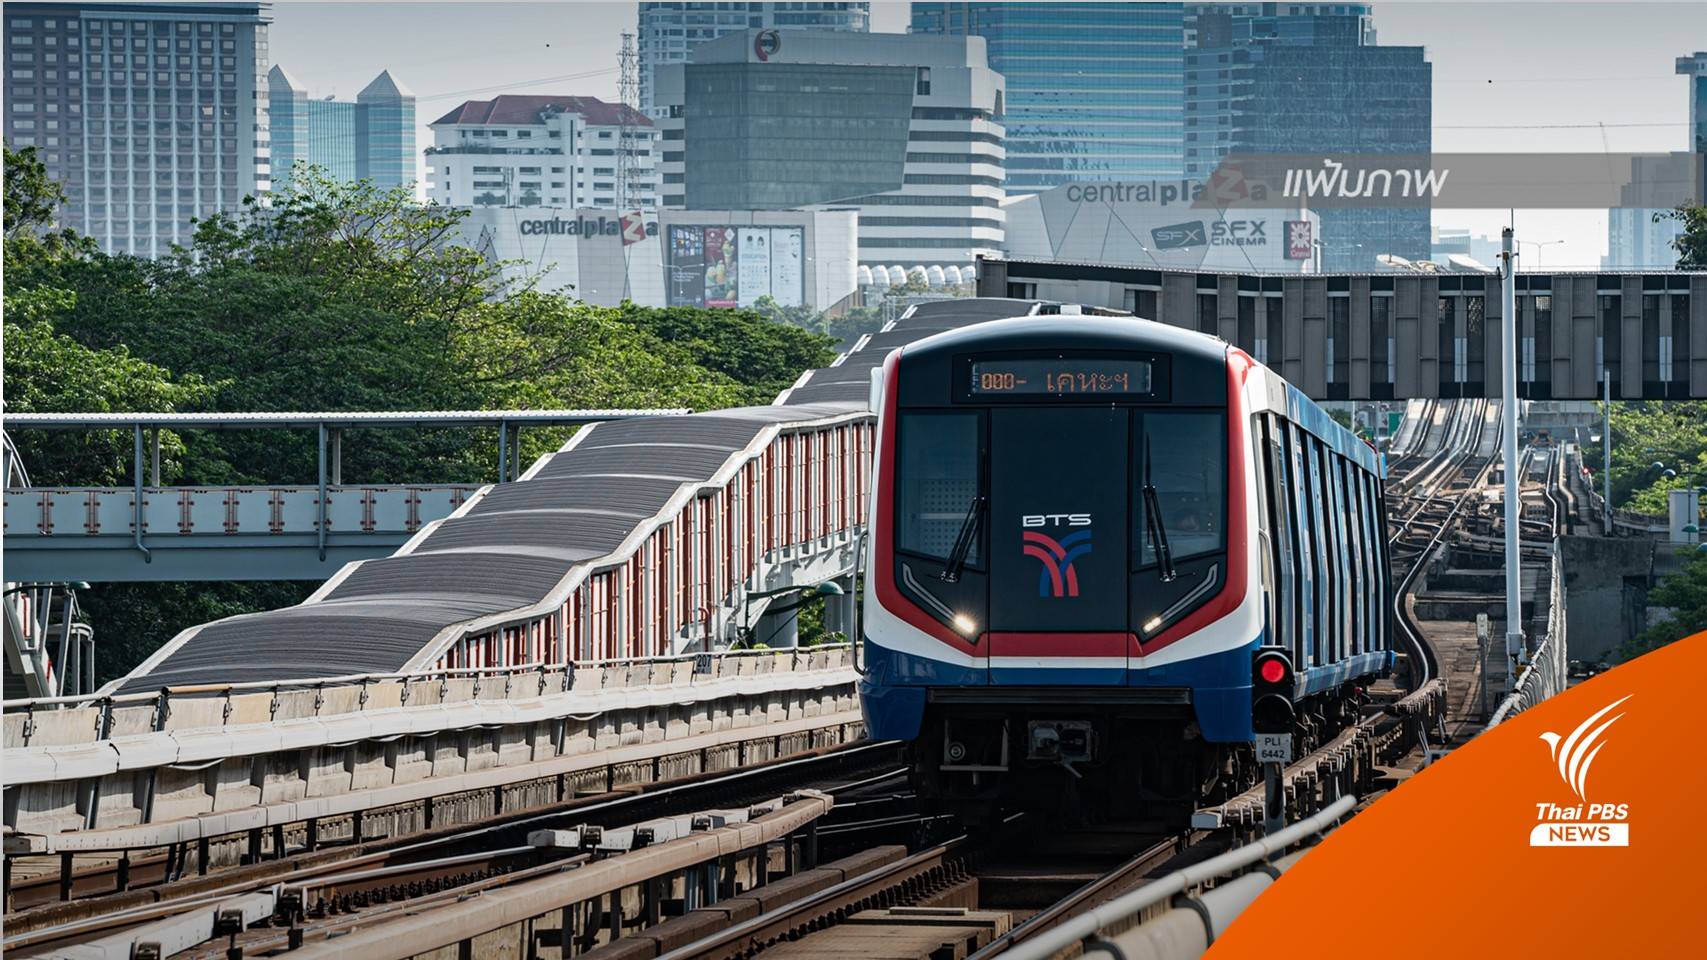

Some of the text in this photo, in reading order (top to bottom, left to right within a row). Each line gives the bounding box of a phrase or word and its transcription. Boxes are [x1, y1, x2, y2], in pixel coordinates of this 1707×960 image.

[1211, 220, 1267, 236] SFX
[1156, 229, 1200, 247] SFX
[1211, 237, 1267, 246] CINEMA
[1022, 513, 1092, 528] BTS
[1264, 737, 1282, 746] PLI
[1261, 749, 1285, 759] 6442
